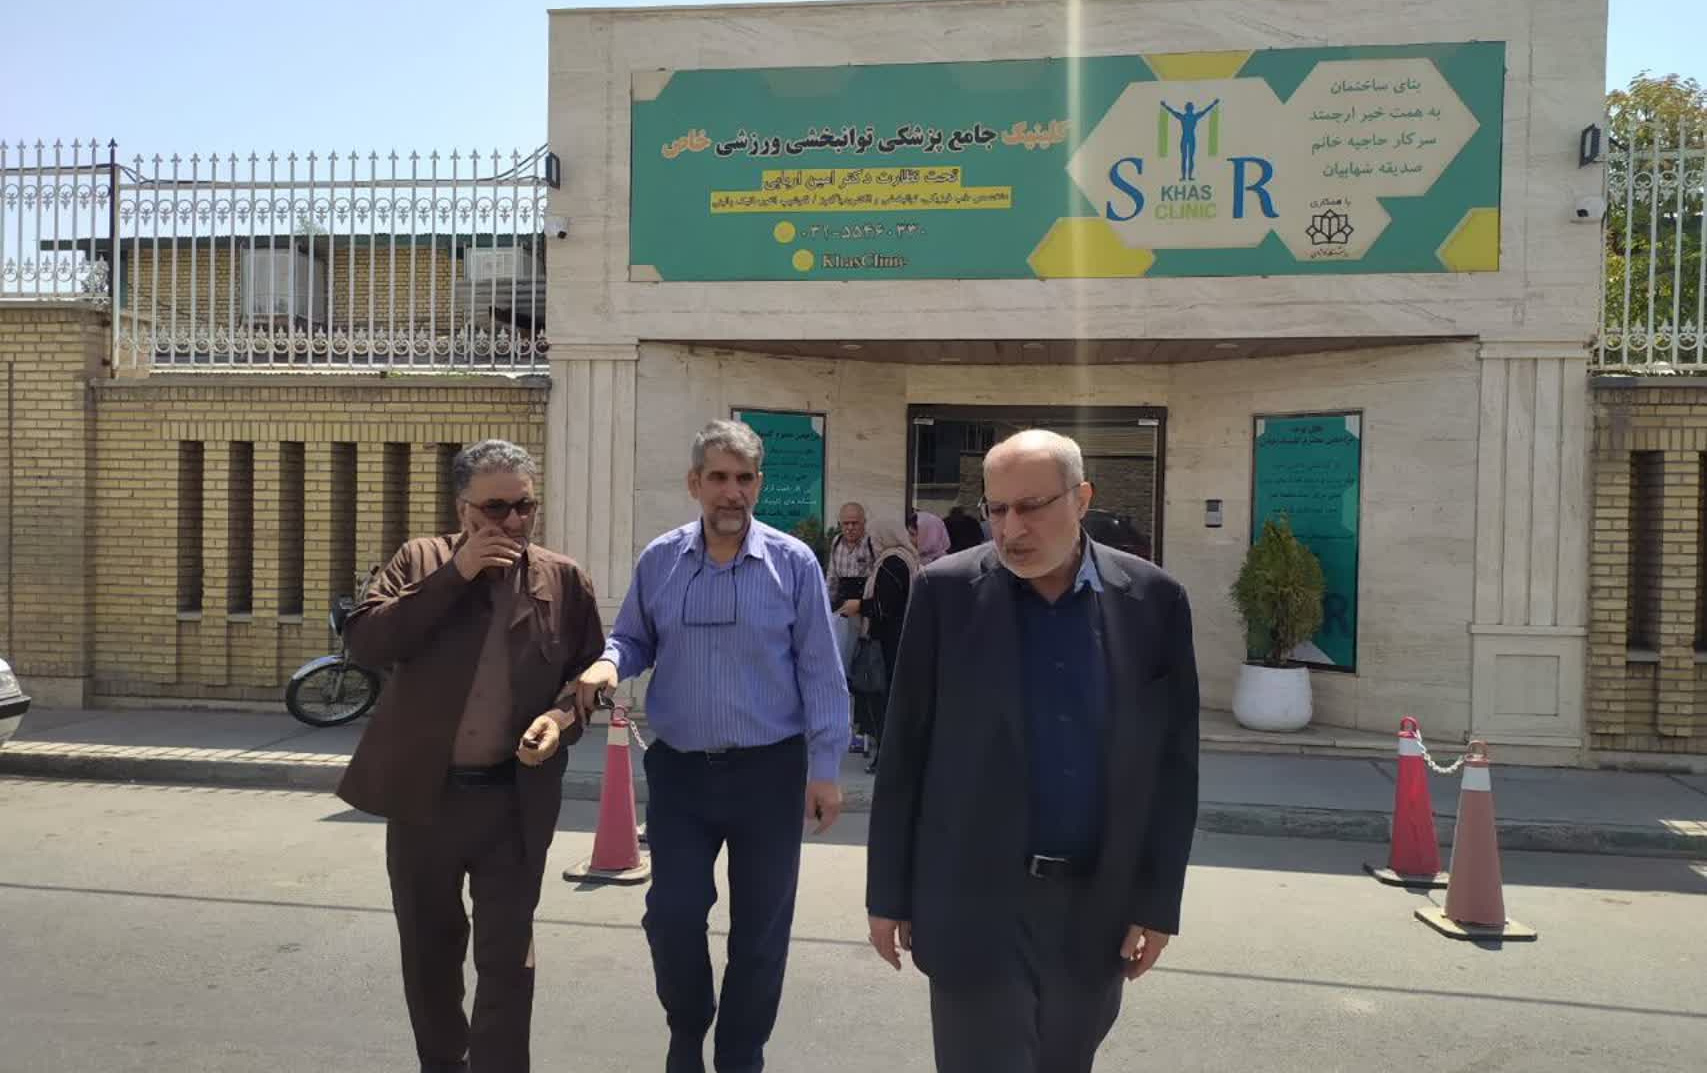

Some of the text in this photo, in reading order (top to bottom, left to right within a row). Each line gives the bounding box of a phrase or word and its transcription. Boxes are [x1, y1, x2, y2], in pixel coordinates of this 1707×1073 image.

[1330, 78, 1388, 95] ساختمان
[1309, 106, 1355, 125] ارجمند
[1390, 108, 1423, 119] همت
[1425, 107, 1441, 121] به
[661, 128, 711, 158] خاص
[715, 129, 781, 156] ورزشی
[785, 125, 873, 154] توانبخشی
[878, 124, 943, 153] پزشکی
[948, 124, 998, 153] جامع
[1311, 133, 1342, 155] خانم
[1348, 133, 1387, 150] حاجیه
[1379, 160, 1423, 176] صدیقه
[806, 170, 835, 190] امین
[1161, 184, 1212, 202] KHAS
[1155, 203, 1217, 220] CLINIC
